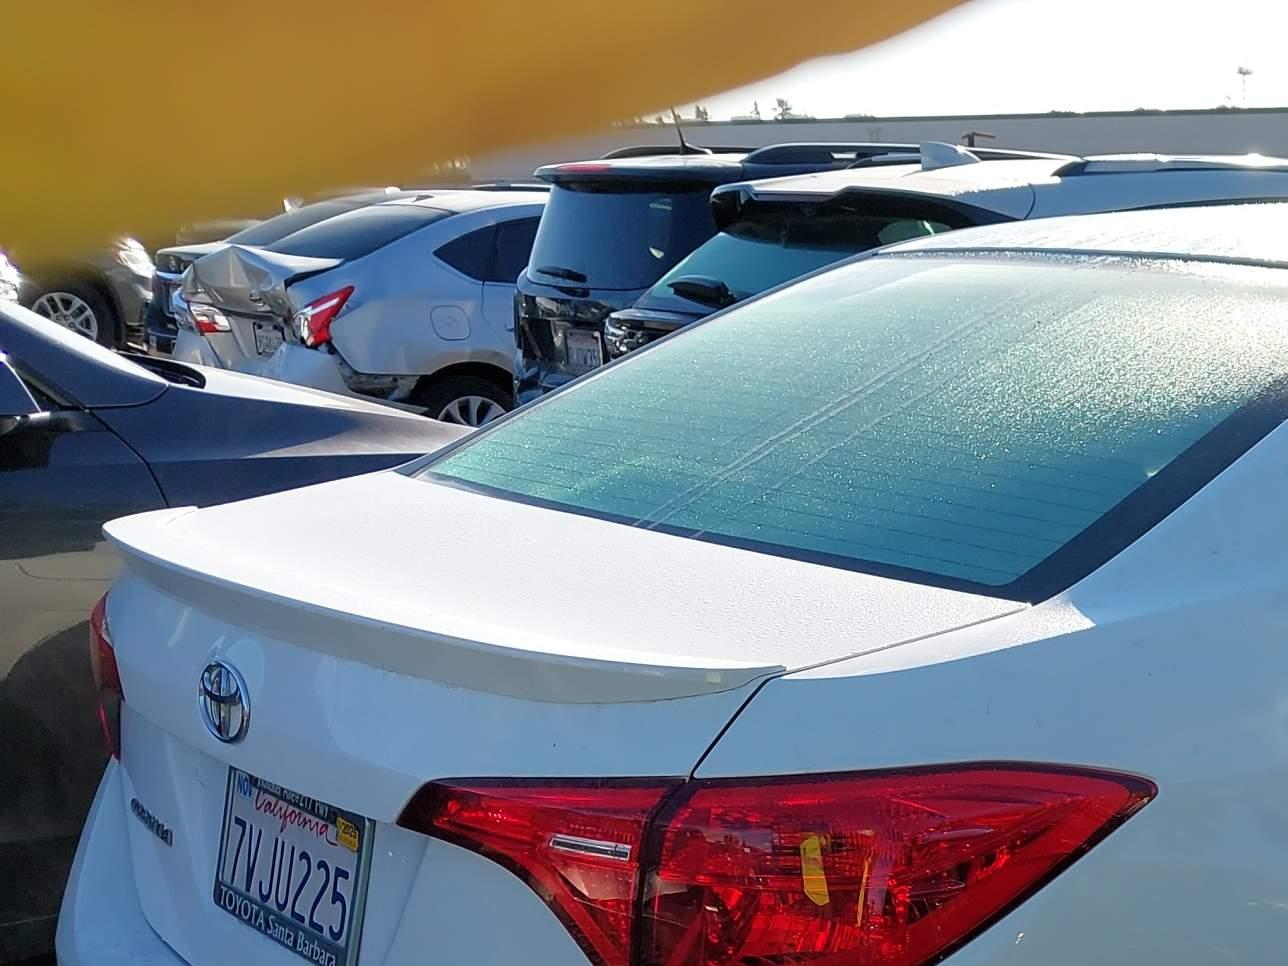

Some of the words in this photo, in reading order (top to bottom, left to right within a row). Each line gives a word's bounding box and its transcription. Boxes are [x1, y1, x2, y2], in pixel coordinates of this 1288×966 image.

[255, 789, 338, 846] California
[231, 815, 350, 942] 7VJU225
[220, 885, 265, 930] TOYOTA
[267, 915, 294, 947] Santa
